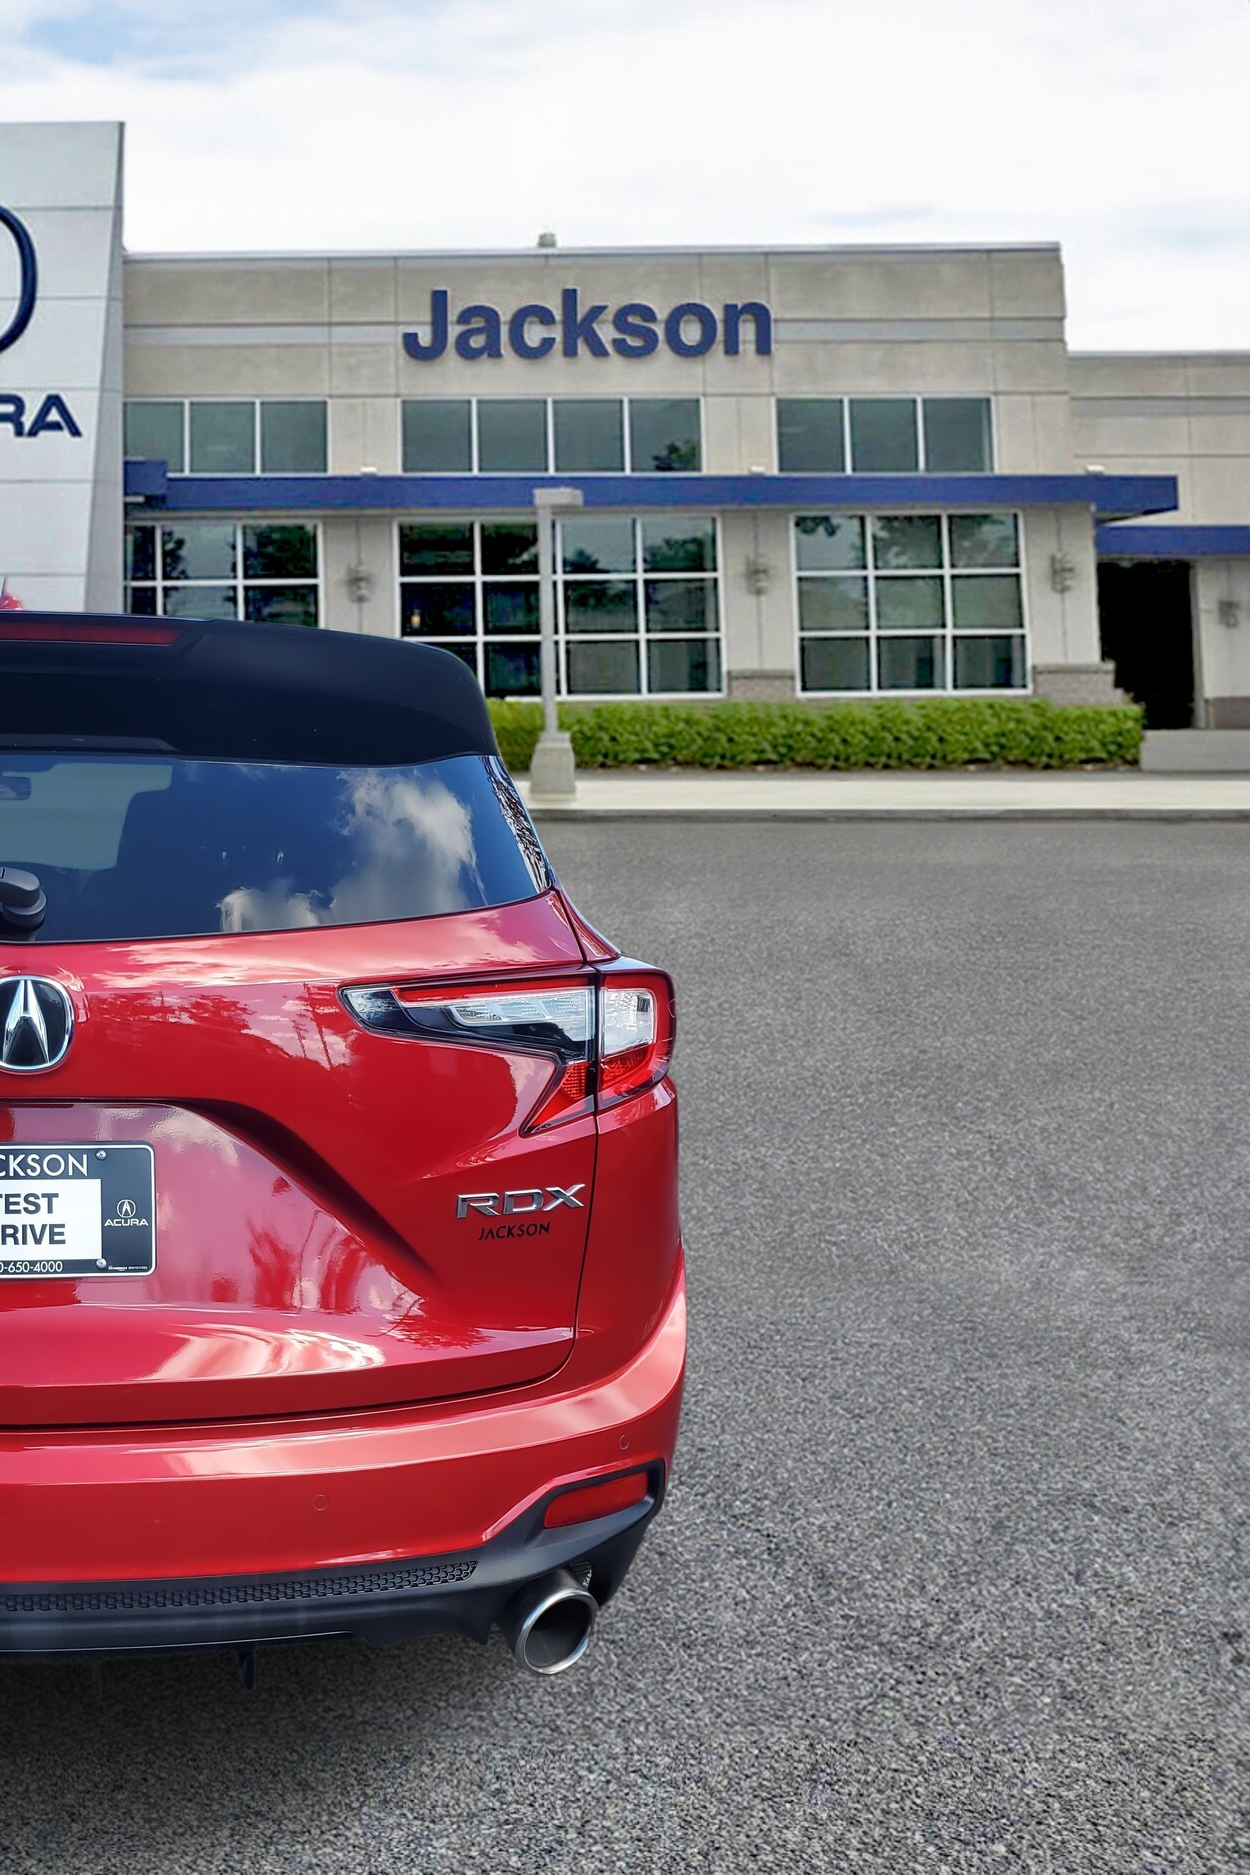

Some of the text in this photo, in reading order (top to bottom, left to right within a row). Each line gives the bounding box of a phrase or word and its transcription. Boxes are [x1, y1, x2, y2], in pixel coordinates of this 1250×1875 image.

[402, 288, 773, 360] Jackson
[456, 1183, 586, 1219] RDX
[104, 1218, 149, 1227] ACURA
[477, 1221, 551, 1241] JACKSON
